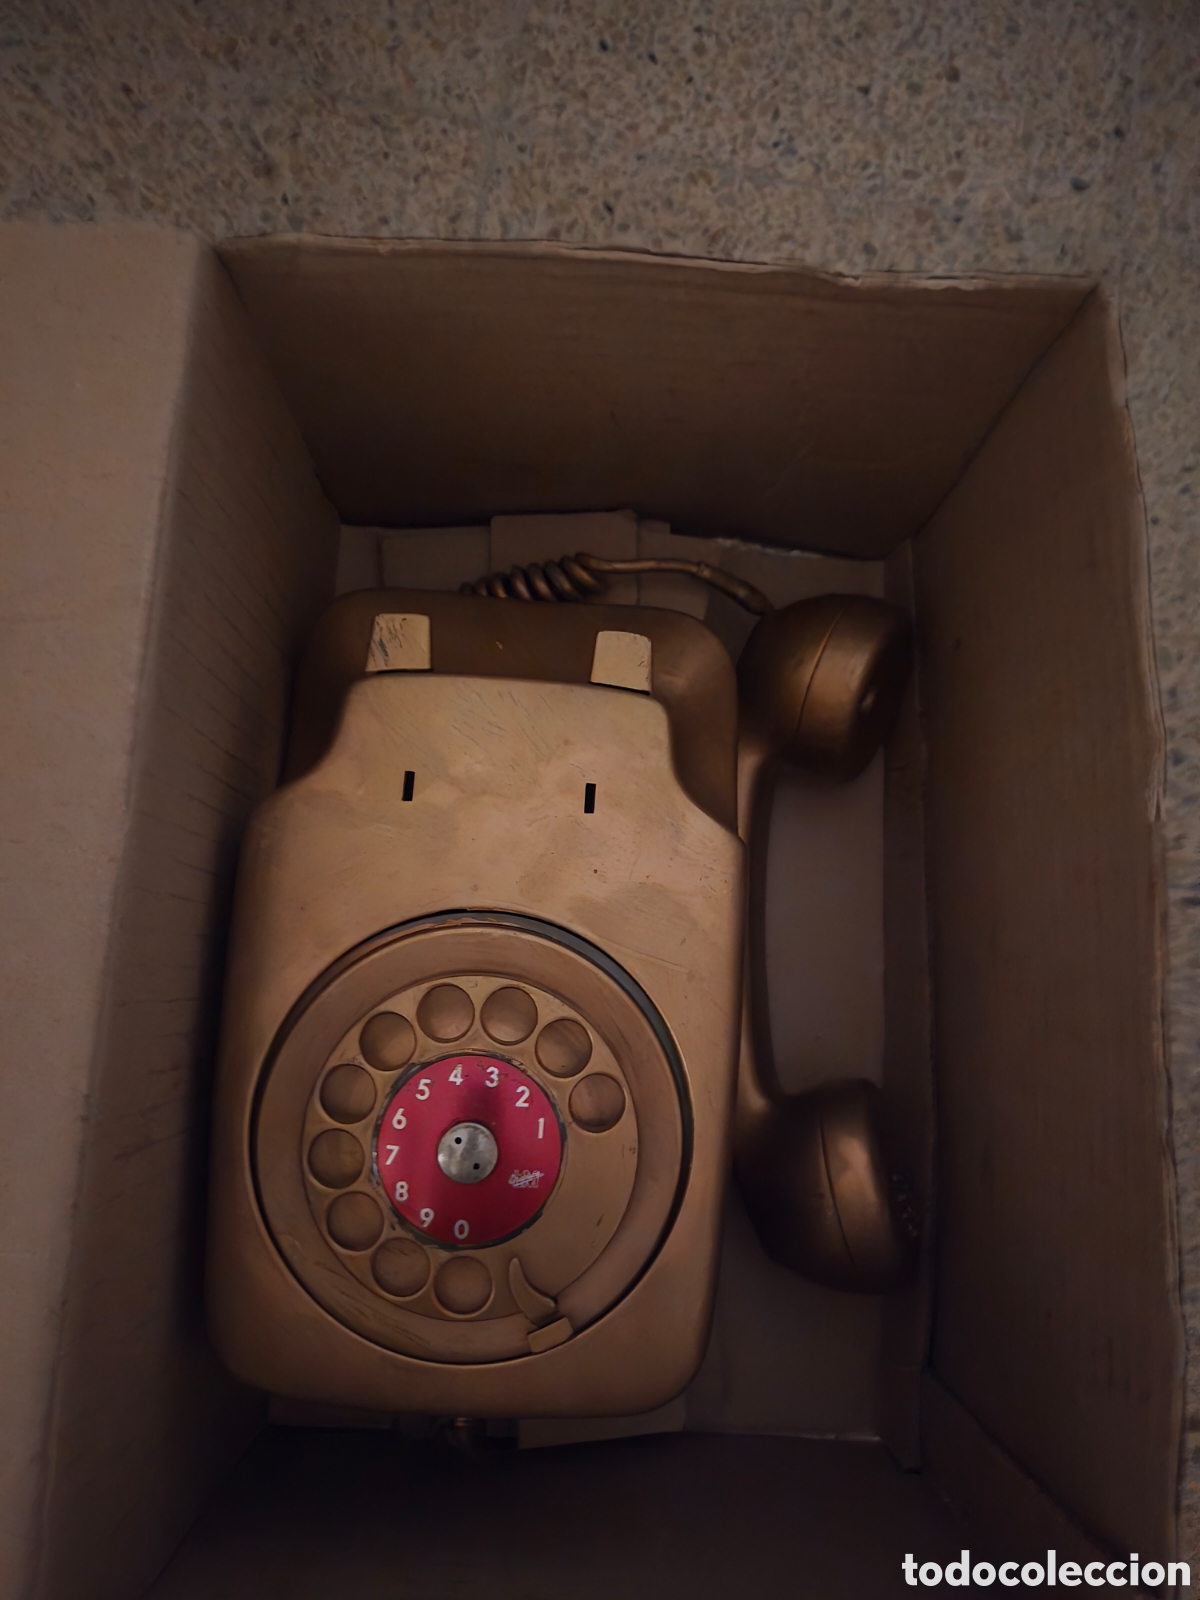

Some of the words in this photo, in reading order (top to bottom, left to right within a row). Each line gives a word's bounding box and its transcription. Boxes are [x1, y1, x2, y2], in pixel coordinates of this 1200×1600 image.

[448, 1063, 464, 1086] 4
[485, 1066, 499, 1087] 3
[415, 1078, 431, 1100] 5
[515, 1085, 530, 1107] 2
[392, 1107, 407, 1130] 6
[537, 1117, 545, 1139] 1
[385, 1144, 400, 1165] 7
[395, 1181, 408, 1201] 8
[420, 1208, 435, 1228] 9
[454, 1219, 469, 1239] 0
